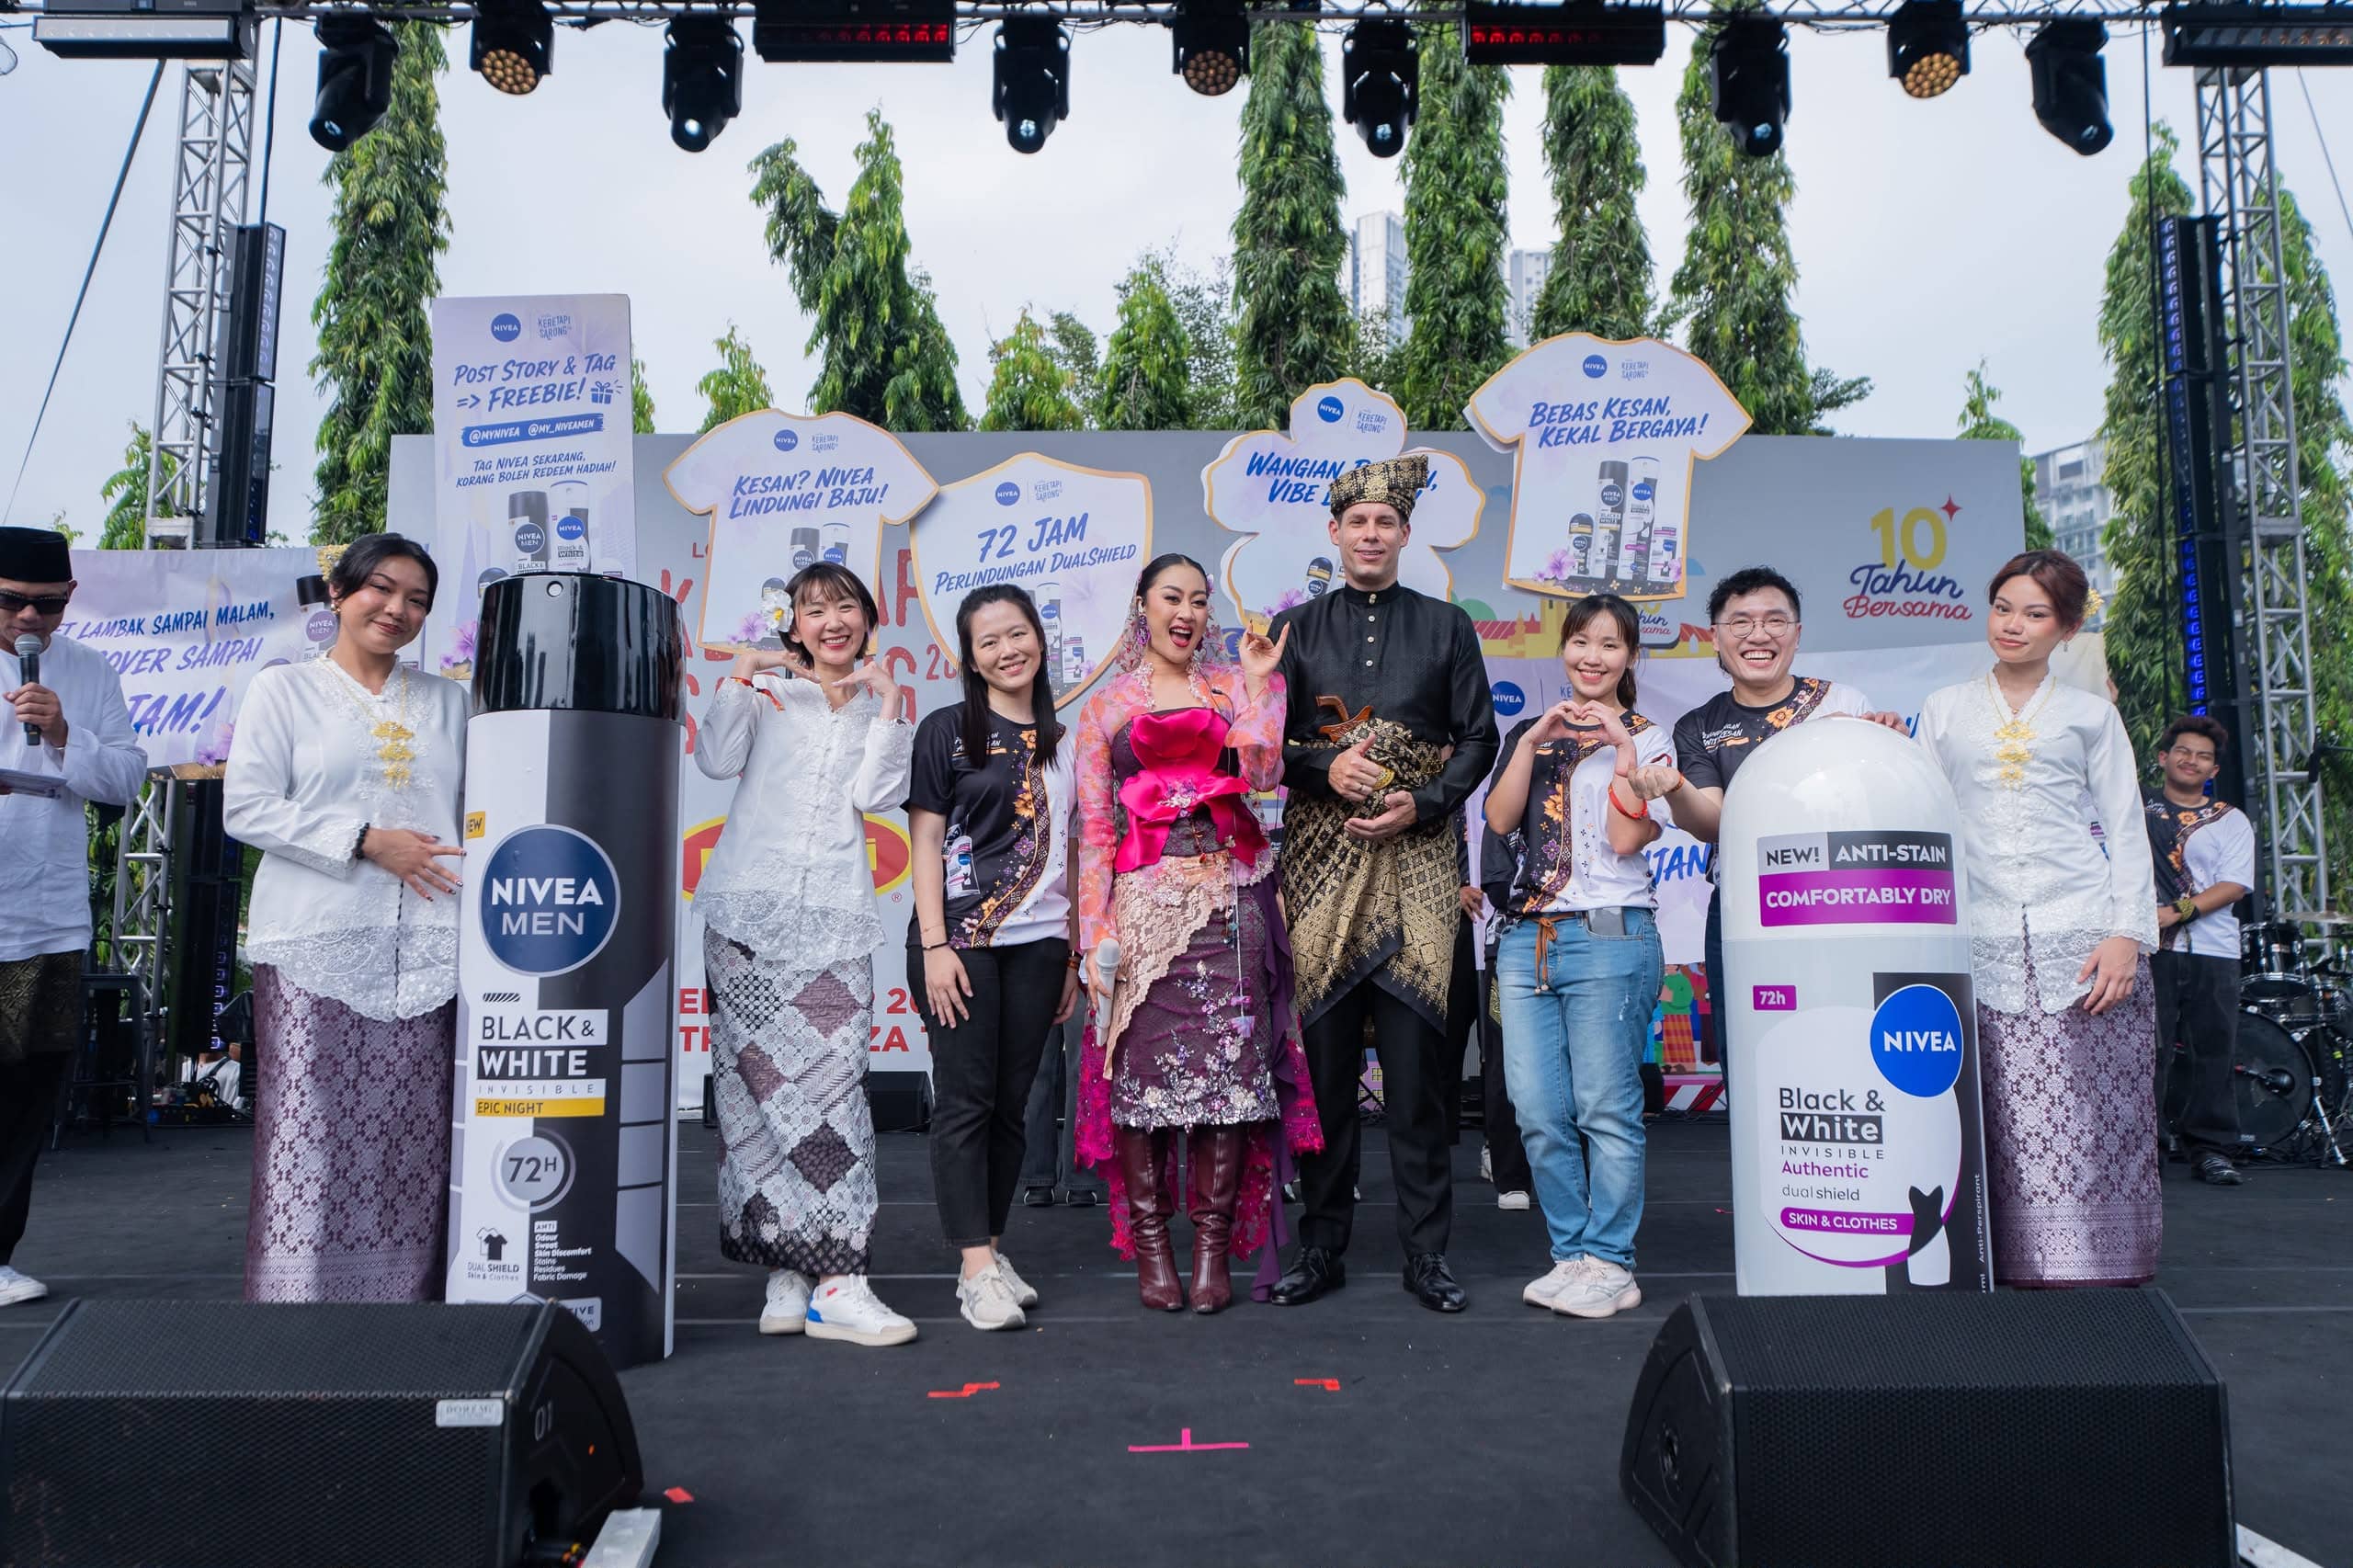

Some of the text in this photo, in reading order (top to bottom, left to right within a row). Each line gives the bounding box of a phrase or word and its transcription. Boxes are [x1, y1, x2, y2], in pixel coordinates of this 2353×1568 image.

[494, 324, 518, 332] NIVEA
[538, 315, 571, 328] KERETAPI
[539, 325, 568, 339] SARONG
[454, 353, 616, 386] POST STORY & TAG
[488, 377, 586, 412] FREEBIE!
[1320, 403, 1341, 416] NIVEA
[1529, 395, 1671, 427] BEBAS KESAN,
[469, 419, 595, 444] @MYNIVEA @MY_NIVEAMEN
[1538, 413, 1710, 449] KEKAL BERGAYA!
[473, 451, 586, 472] TAG NIVEA SEKARANG,
[1246, 451, 1346, 479] WANGIAN
[456, 460, 617, 488] KORANG BOLEH REDEEM HADIAH!
[733, 467, 874, 496] KESAN? NIVEA
[729, 483, 889, 519] LINDUNGI BAJU!
[1267, 478, 1320, 503] VIBE
[978, 512, 1089, 563] 72 JAM
[1870, 506, 1948, 571] 10
[934, 558, 1047, 596] PERLINDUNGAN
[1849, 558, 1964, 599] Tahun
[1843, 595, 1972, 620] Bersama
[76, 618, 145, 640] LAMBAK
[152, 610, 209, 636] SAMPAI
[215, 601, 274, 626] MALAM,
[309, 619, 334, 629] NIVEA
[100, 638, 264, 676] OVER SAMPAI
[1493, 694, 1522, 703] NIVEA
[1767, 844, 1947, 867] NEW! ANTI-STAIN
[492, 877, 604, 905] NIVEA
[1766, 886, 1951, 908] COMFORTABLY DRY
[501, 912, 585, 936] MEN
[1759, 990, 1786, 1005] 72h
[482, 1016, 595, 1040] BLACK &
[1883, 1030, 1957, 1052] NIVEA
[481, 1050, 588, 1077] WHITE
[478, 1084, 595, 1095] INVISIBLE
[1779, 1087, 1886, 1112] Black &
[477, 1101, 543, 1114] EPIC NIGHT
[1782, 1114, 1879, 1142] White
[1781, 1145, 1884, 1160] INVISIBLE
[1781, 1160, 1869, 1178] Authentic
[1788, 1212, 1898, 1231] SKIN & CLOTHES
[1974, 1173, 1985, 1263] Anti-Perspirant
[535, 1233, 559, 1242] Odour
[534, 1247, 592, 1258] Skin Discomfort
[468, 1262, 520, 1273] DUAL SHIELD
[489, 1273, 519, 1281] Clothes
[533, 1266, 565, 1274] Residues
[533, 1271, 588, 1281] Fabric Damage
